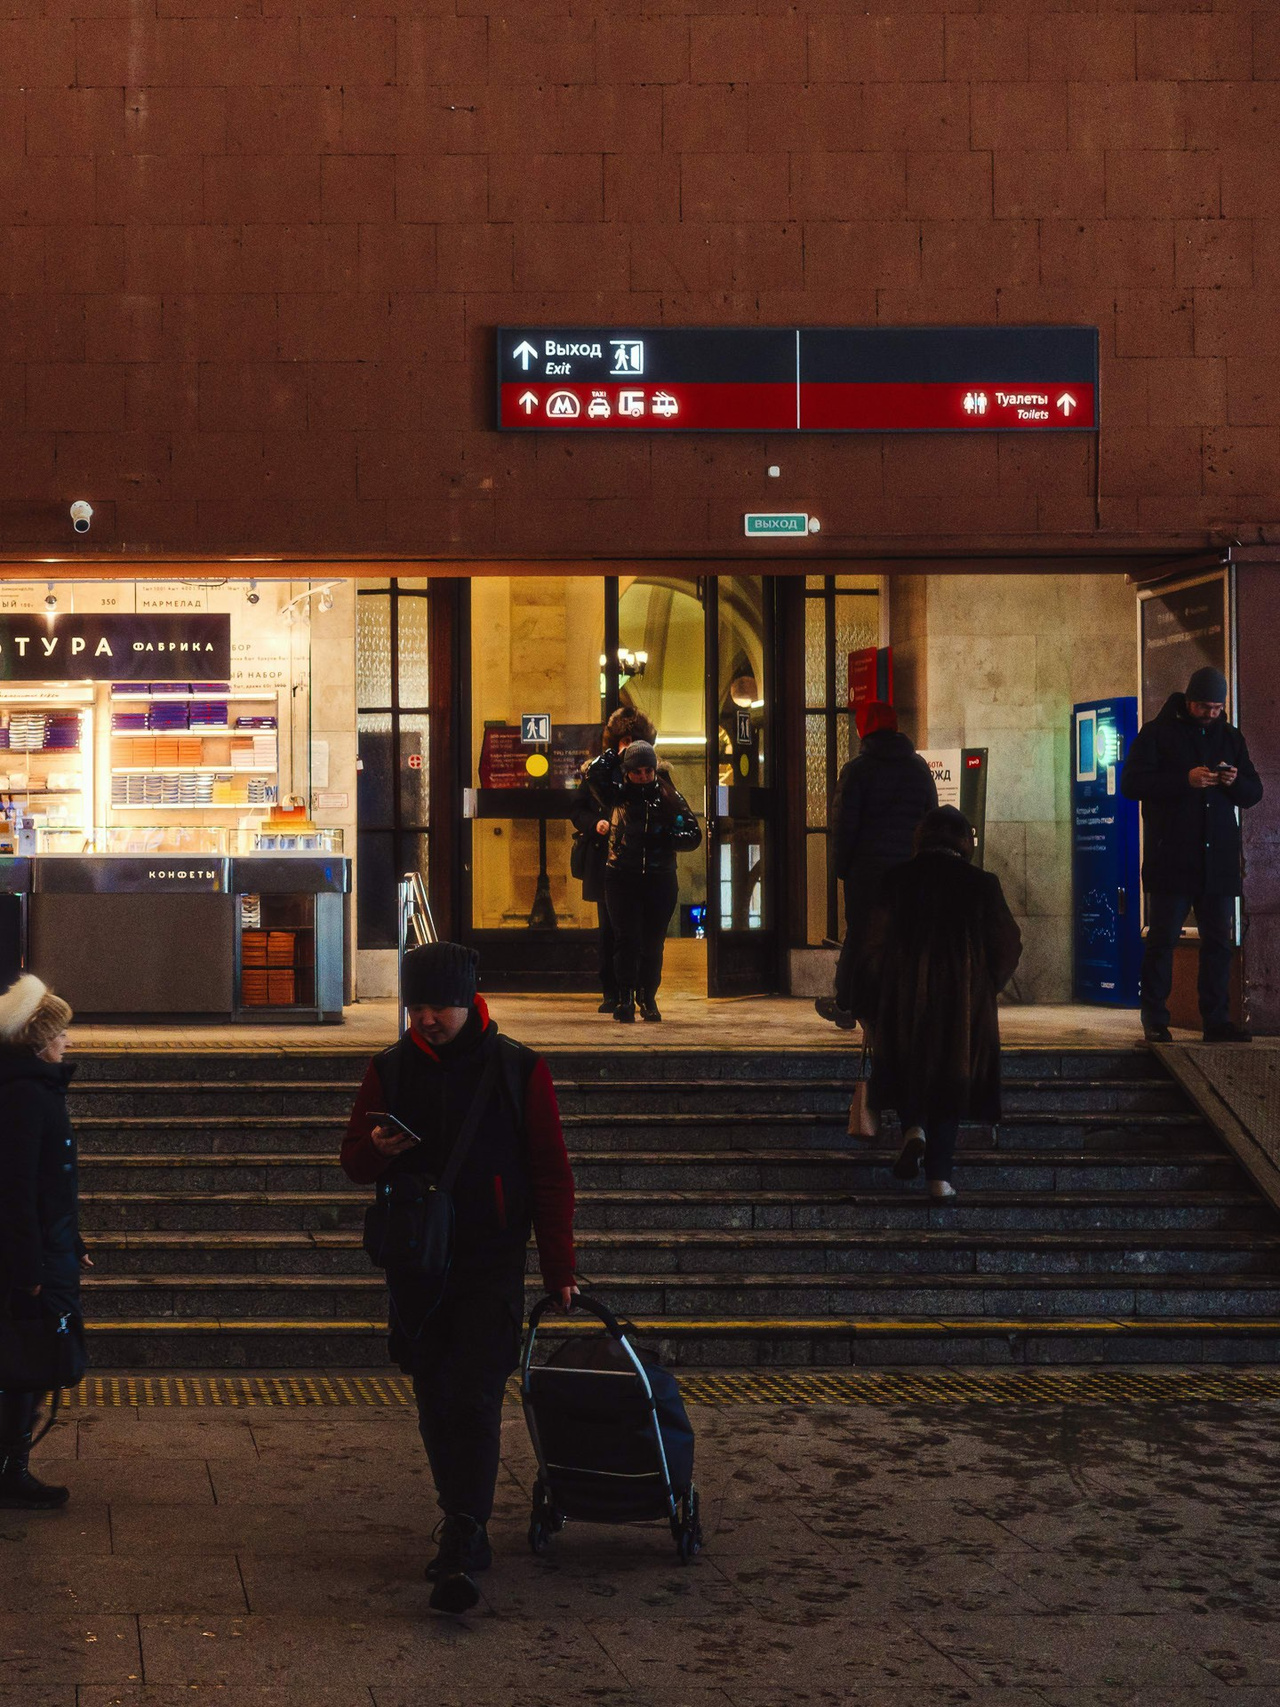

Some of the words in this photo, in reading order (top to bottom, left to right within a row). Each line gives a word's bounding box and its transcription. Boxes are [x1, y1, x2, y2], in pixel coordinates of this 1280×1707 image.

[545, 340, 602, 358] Выход
[545, 362, 572, 375] Exit
[995, 392, 1048, 407] Туалеты
[1017, 409, 1049, 420] Toilets
[754, 519, 798, 529] ВЫХОД
[101, 598, 117, 606] 350
[143, 600, 202, 608] МАРМЕЛАД
[132, 642, 214, 652] ФАБРИКА
[248, 671, 283, 679] НАБОР
[149, 870, 215, 879] КОНФЕТЫ
